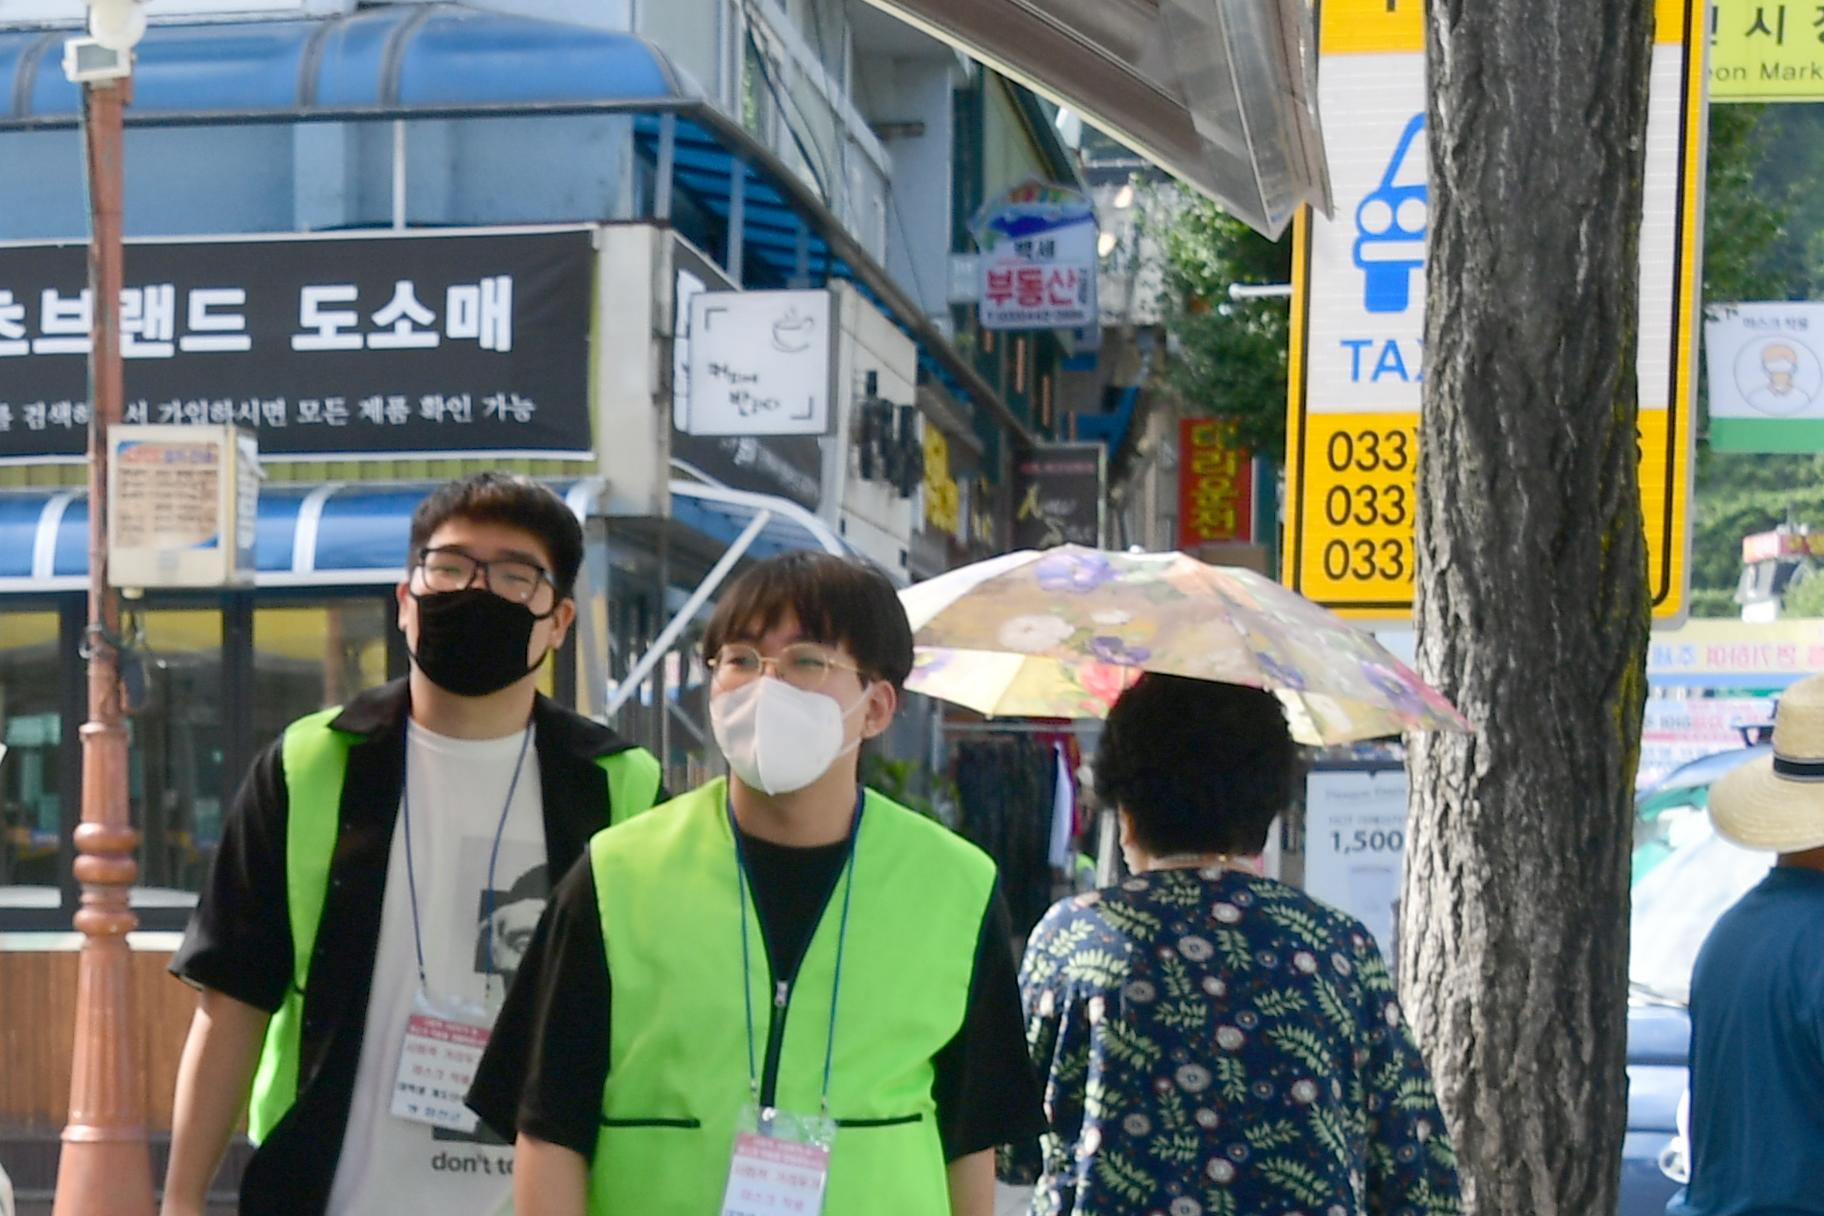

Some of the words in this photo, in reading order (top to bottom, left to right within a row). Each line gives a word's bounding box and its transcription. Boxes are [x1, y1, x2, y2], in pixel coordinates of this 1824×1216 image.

[1709, 66, 1747, 81] on
[986, 267, 1078, 307] 부동산
[292, 275, 513, 352] 도소매
[1341, 339, 1425, 382] TA
[297, 396, 350, 427] 모든
[481, 391, 536, 423] 가능
[1331, 829, 1404, 855] 1,500
[432, 1151, 491, 1174] don't
